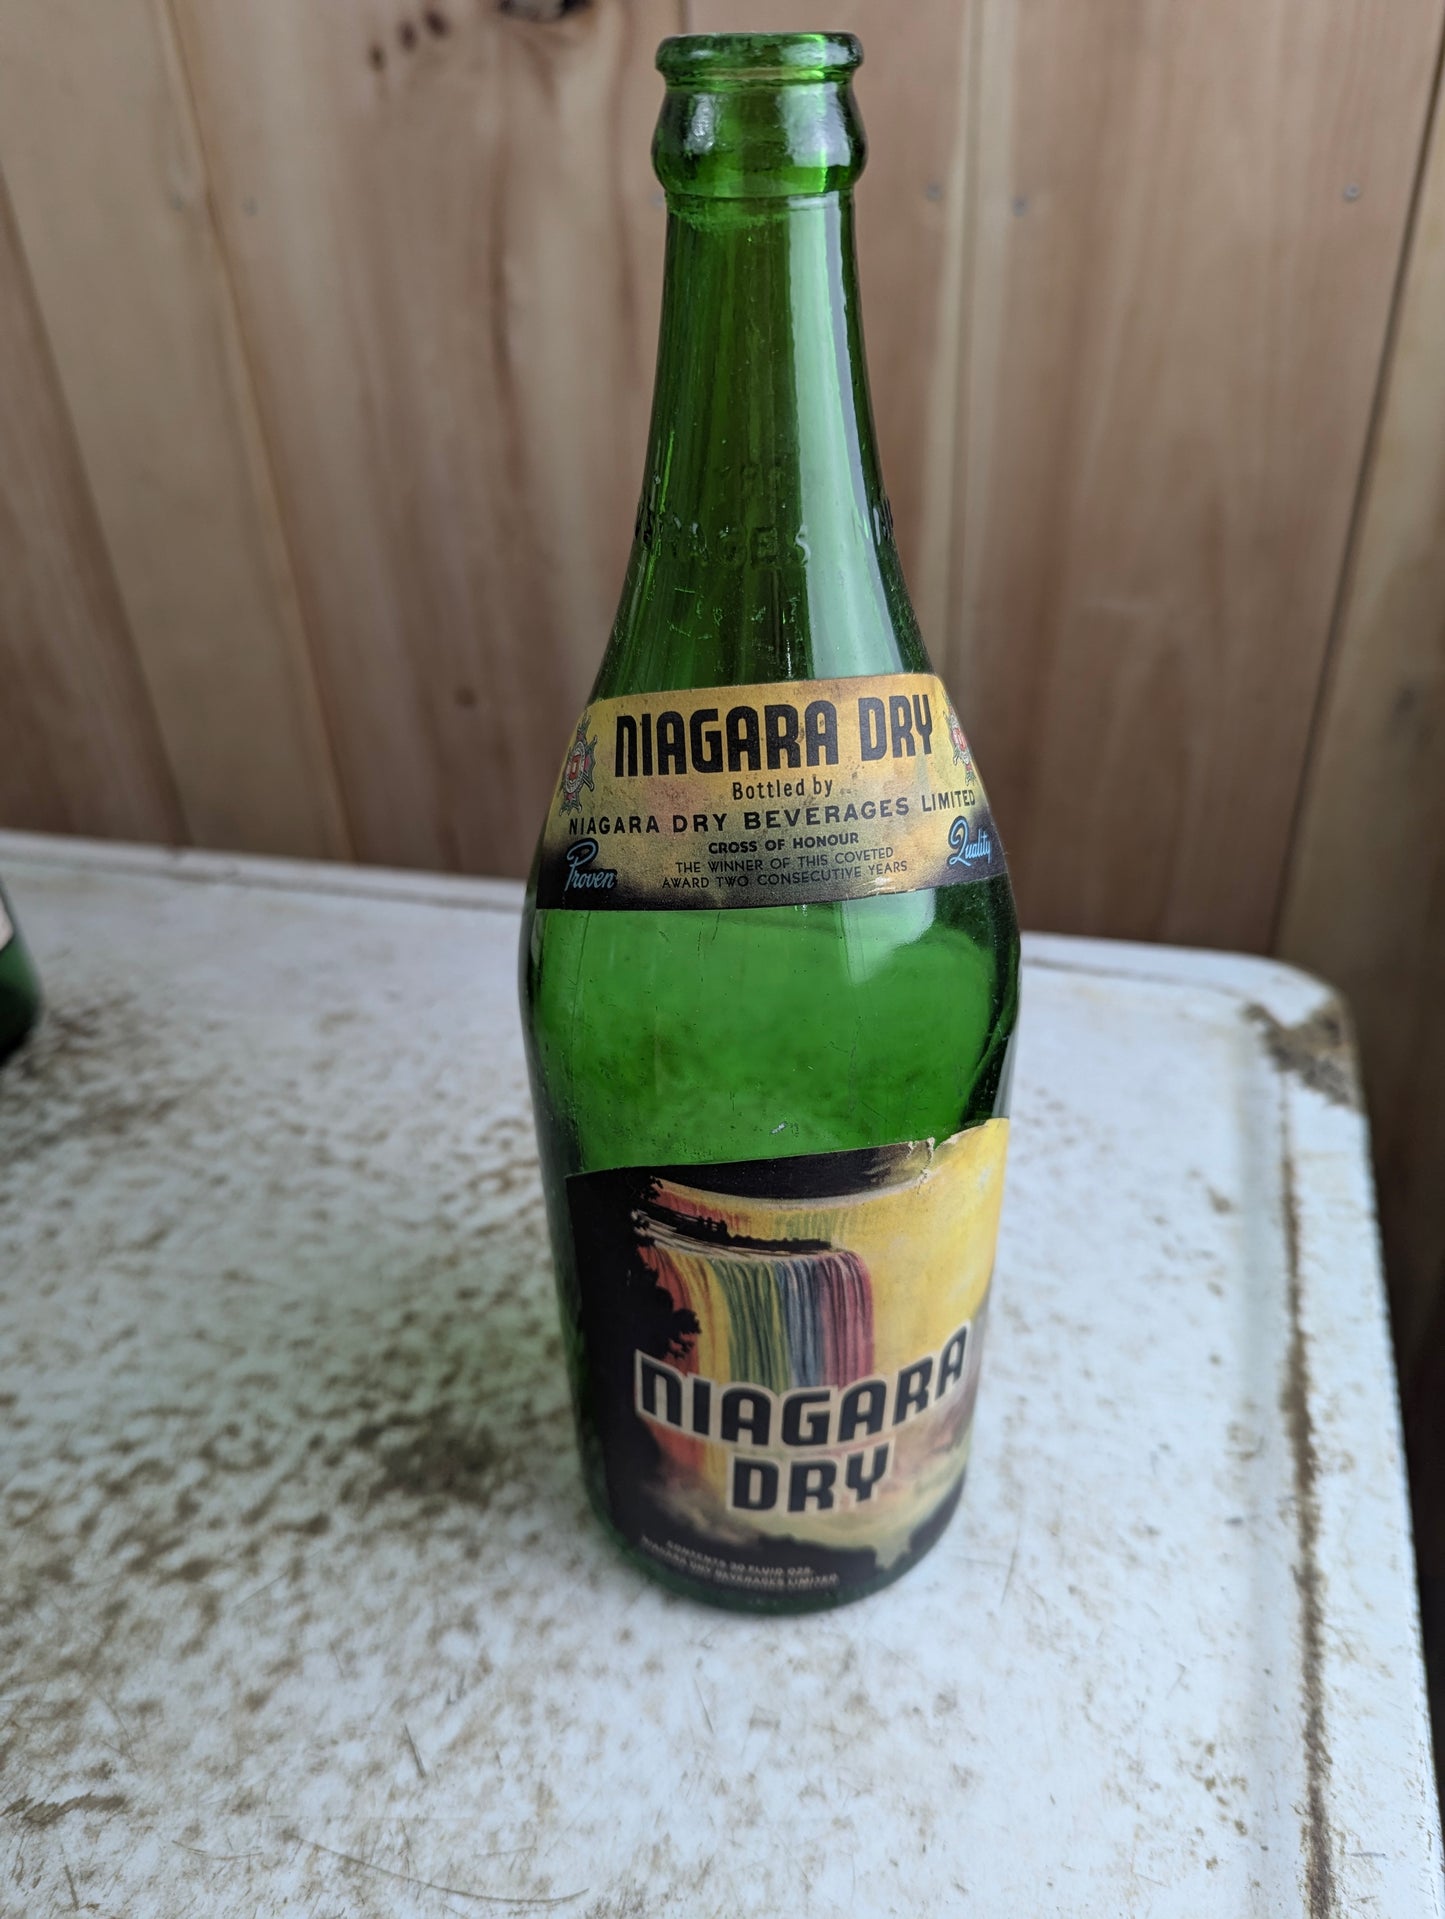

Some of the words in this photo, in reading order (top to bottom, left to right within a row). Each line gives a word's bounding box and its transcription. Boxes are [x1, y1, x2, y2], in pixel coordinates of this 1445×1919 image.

[615, 700, 839, 777] NIAGARA
[858, 694, 933, 762] DRY
[732, 778, 805, 800] Bottled
[813, 777, 833, 797] by
[569, 815, 660, 836] NIAGARA
[673, 813, 728, 833] DRY
[744, 797, 910, 830] BEVERAGES
[922, 790, 976, 812] LIMITED
[564, 839, 617, 891] Proven
[675, 861, 702, 874] THE
[707, 859, 764, 872] WINNER
[770, 855, 791, 869] OF
[798, 854, 828, 867] THIS
[835, 847, 894, 865] COVETED
[708, 841, 758, 854] CROSS
[765, 839, 786, 851] OF
[793, 832, 859, 849] HONOUR
[949, 816, 993, 867] Quality
[661, 876, 710, 889] AWARD
[716, 874, 749, 888] TWO
[757, 865, 862, 887] CONSECUTIVE
[868, 860, 908, 874] YEARS
[638, 1322, 970, 1447] NIAGARA
[728, 1444, 892, 1514] DRY
